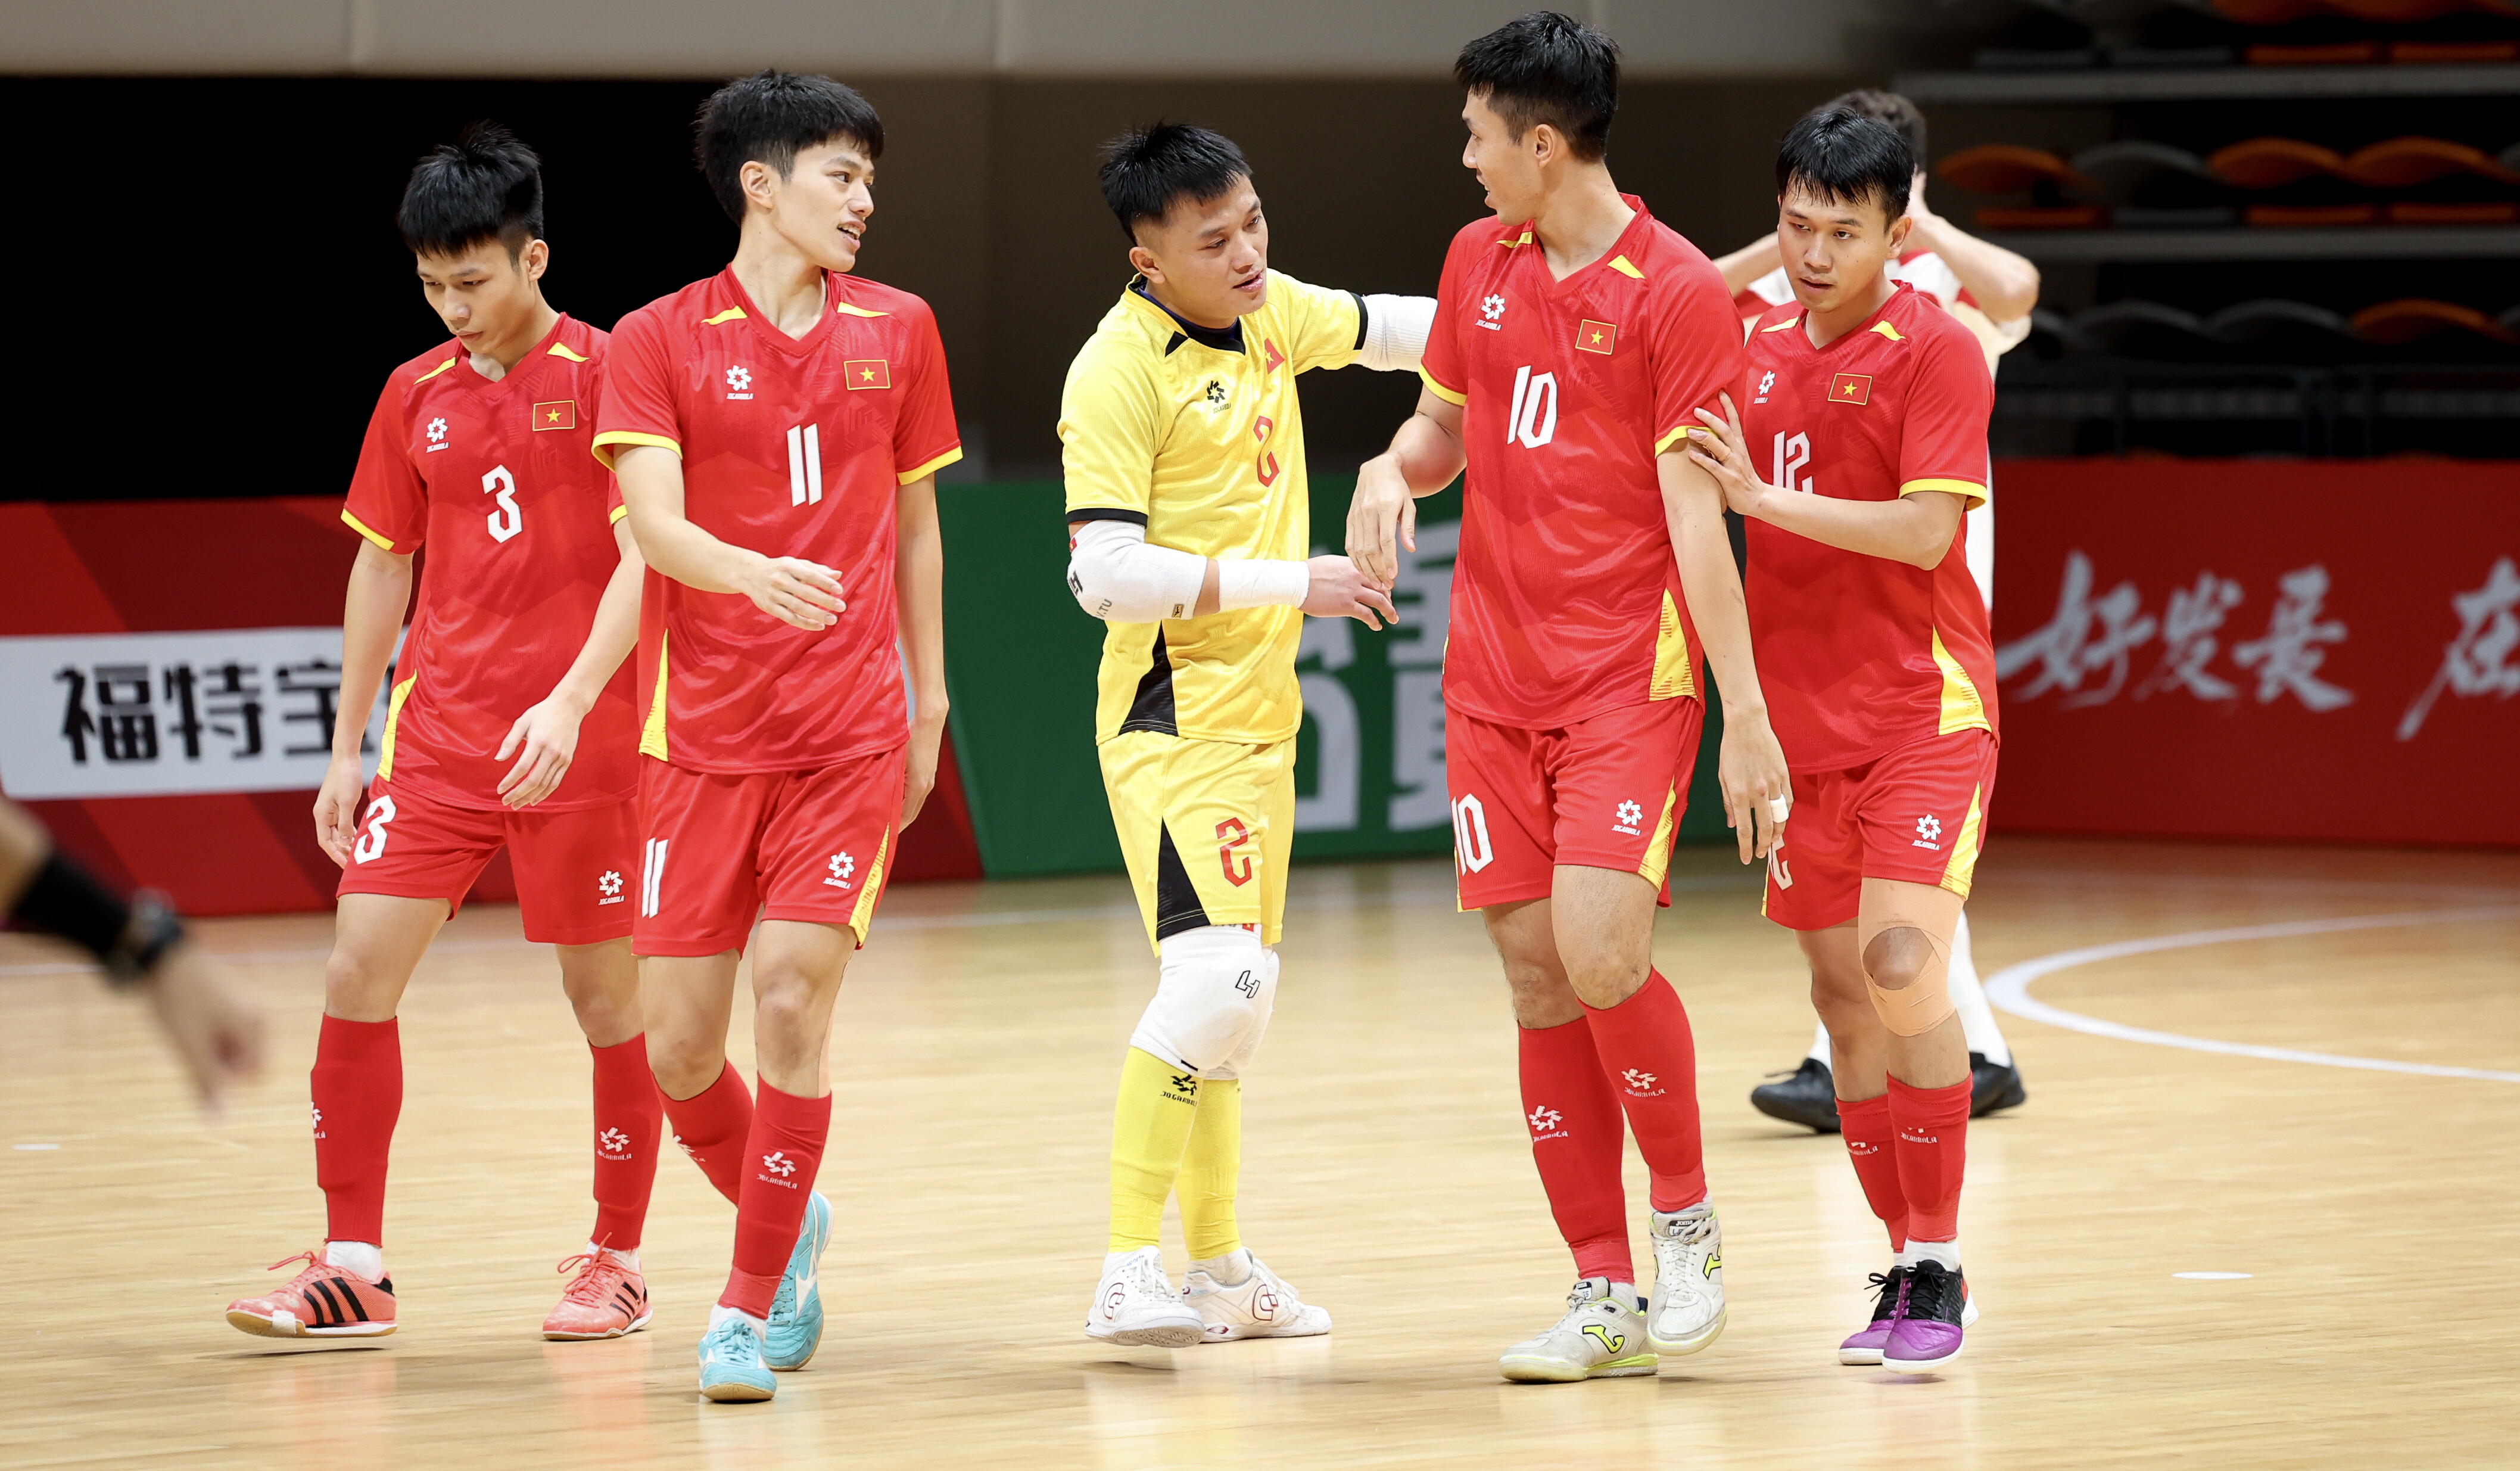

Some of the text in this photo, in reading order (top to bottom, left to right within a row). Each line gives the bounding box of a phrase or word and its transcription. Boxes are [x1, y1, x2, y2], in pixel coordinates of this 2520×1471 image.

[1507, 365, 1558, 449] 10
[786, 423, 823, 507] 11
[1253, 415, 1280, 488] 2
[1773, 430, 1814, 494] 12
[481, 465, 523, 543] 3
[353, 795, 397, 865] 3
[1215, 817, 1252, 888] 2
[1451, 793, 1494, 876] 10
[641, 837, 669, 918] 11
